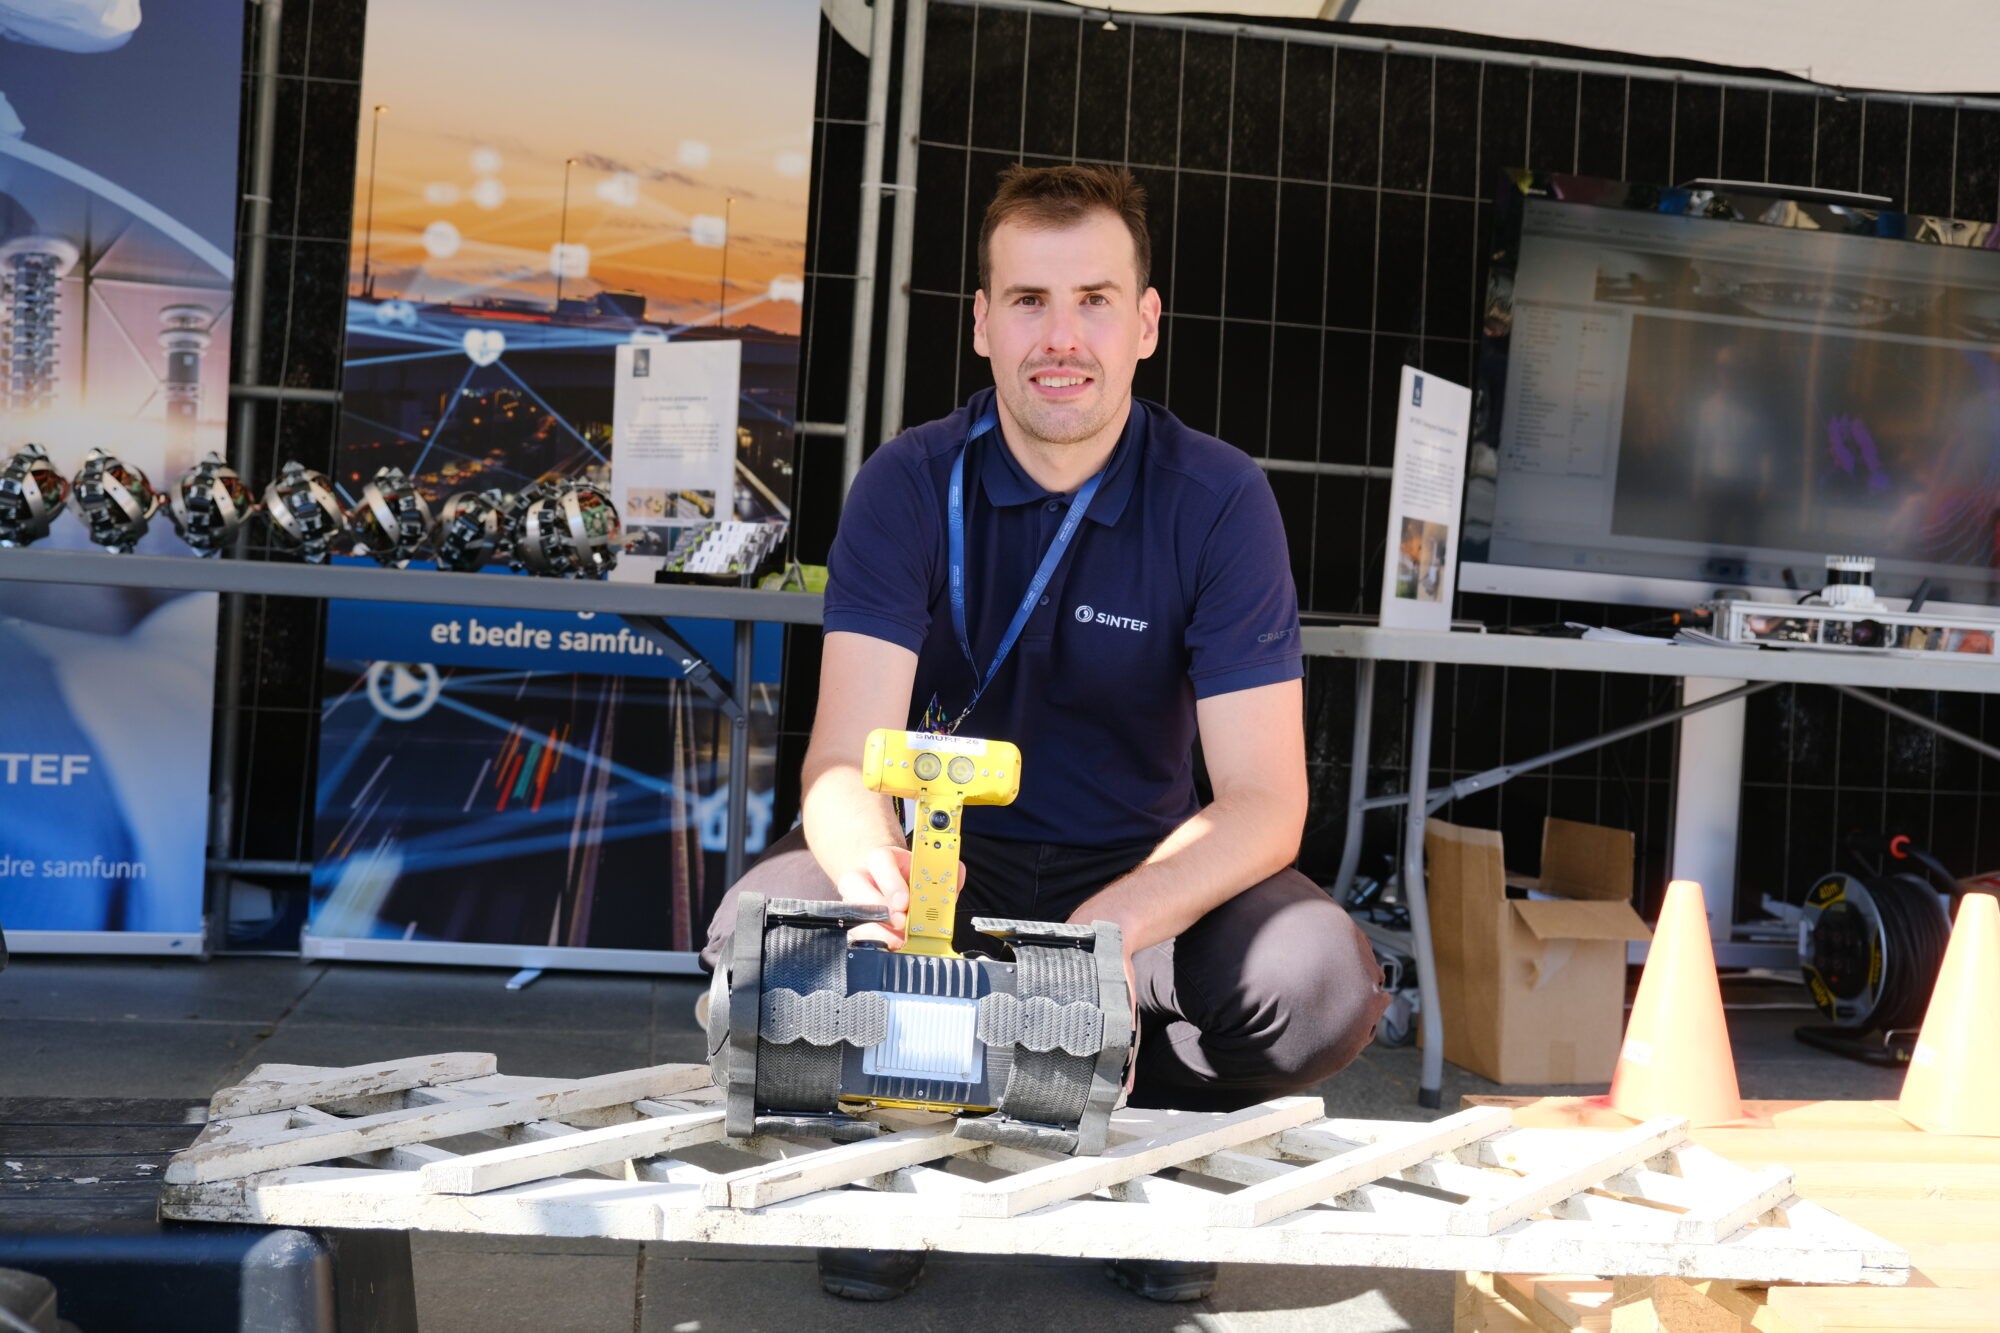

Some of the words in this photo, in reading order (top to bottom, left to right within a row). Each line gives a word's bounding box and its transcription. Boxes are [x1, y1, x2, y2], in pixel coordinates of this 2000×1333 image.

[431, 621, 461, 644] et
[468, 619, 552, 649] bedre
[1095, 612, 1149, 633] SINTEF
[1257, 627, 1295, 643] CRAFT
[0, 753, 91, 785] TEF
[42, 855, 147, 879] samfunn
